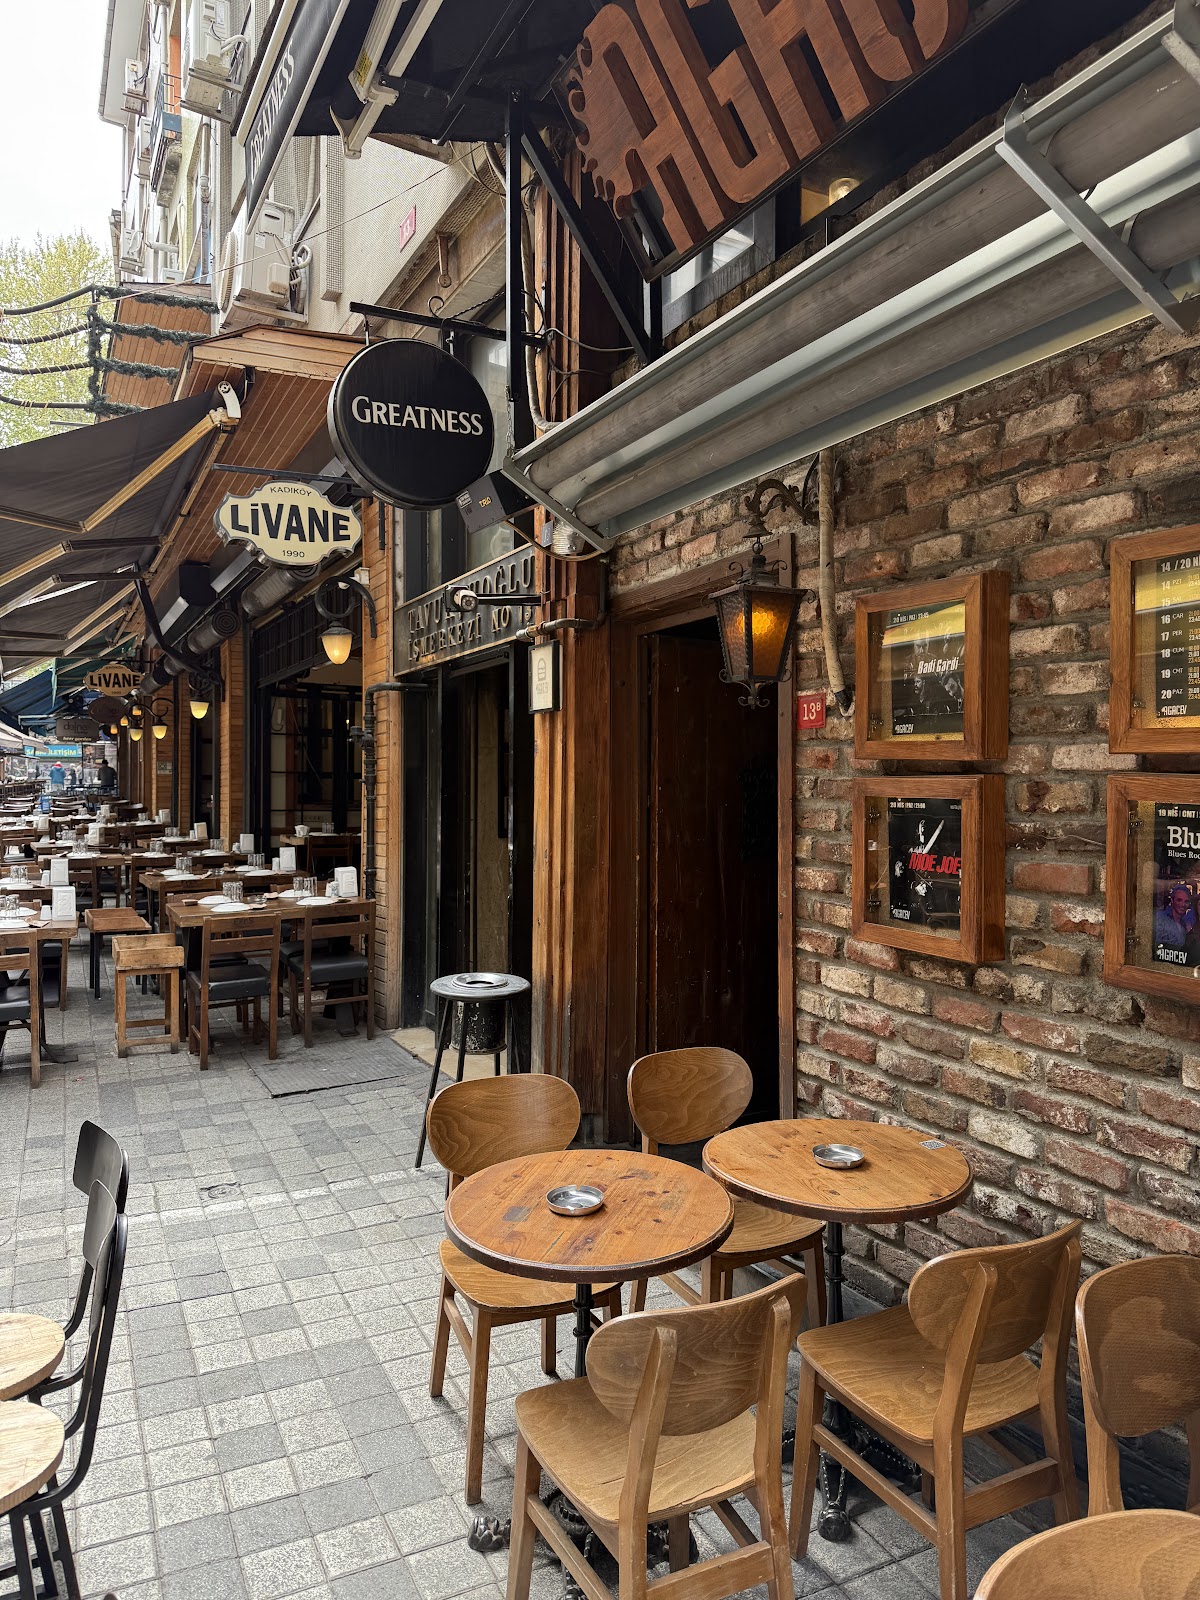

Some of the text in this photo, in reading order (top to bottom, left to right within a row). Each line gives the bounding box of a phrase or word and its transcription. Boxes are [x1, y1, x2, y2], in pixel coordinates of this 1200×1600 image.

[250, 38, 295, 185] GREATNESS
[352, 395, 484, 436] GREATNESS
[269, 486, 312, 497] KADIKÖY
[282, 550, 306, 558] 1990
[1161, 561, 1171, 573] 14
[1180, 557, 1192, 569] 20
[1161, 580, 1171, 590] 14
[492, 605, 513, 633] NO
[1161, 614, 1171, 625] 16
[1161, 631, 1170, 641] 17
[1161, 648, 1171, 659] 18
[1161, 668, 1171, 679] 19
[1161, 689, 1172, 699] 20
[1158, 808, 1167, 817] 19
[1181, 810, 1196, 819] CMT
[1167, 849, 1187, 858] Blues
[908, 852, 962, 875] MOE JOE
